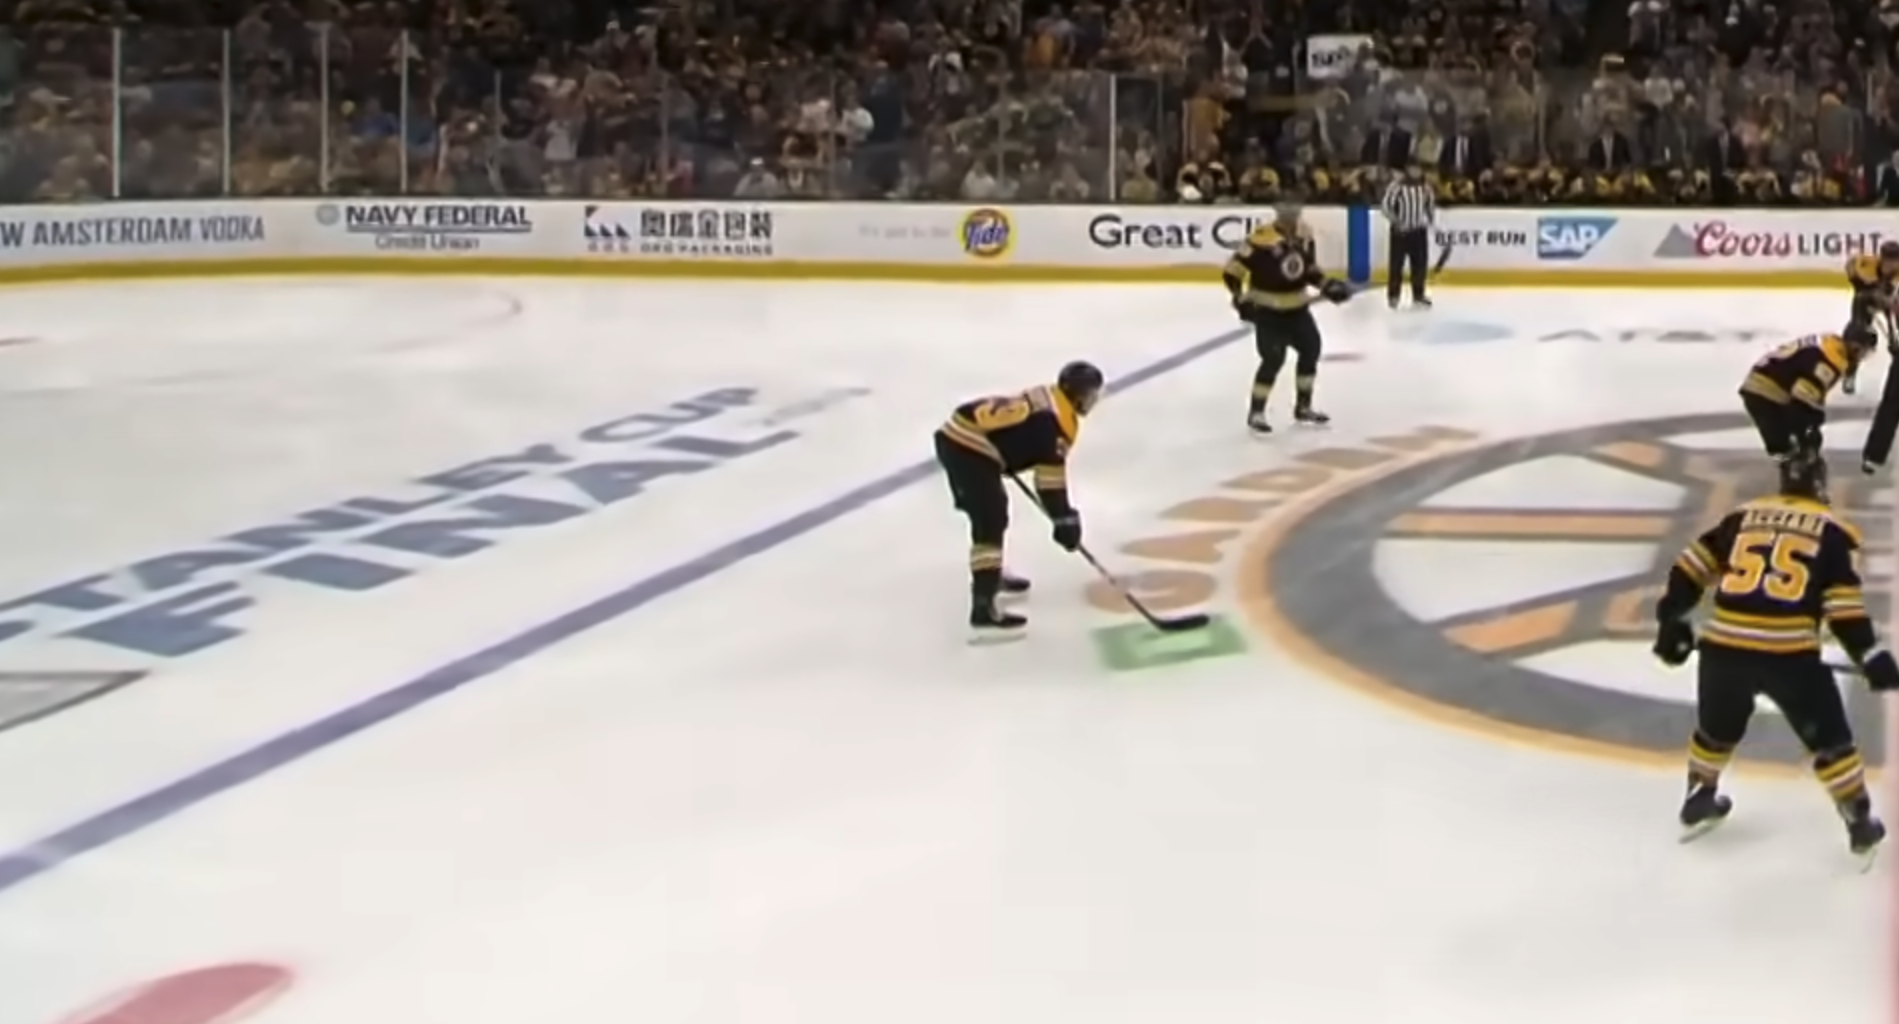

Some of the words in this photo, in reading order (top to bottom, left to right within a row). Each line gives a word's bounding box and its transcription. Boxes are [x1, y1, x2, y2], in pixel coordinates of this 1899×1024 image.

[32, 218, 191, 245] AMSTERDAM
[200, 216, 265, 242] VODKA
[346, 205, 417, 225] NAVY
[424, 205, 532, 226] FEDERAL
[1089, 214, 1202, 248] Great
[963, 216, 1010, 253] Tide
[1486, 229, 1527, 246] RUN
[1539, 222, 1599, 252] SAP
[1694, 219, 1793, 258] Coors
[1799, 232, 1883, 257] LIGHT
[55, 430, 803, 657] FINAL
[1720, 530, 1821, 602] 55
